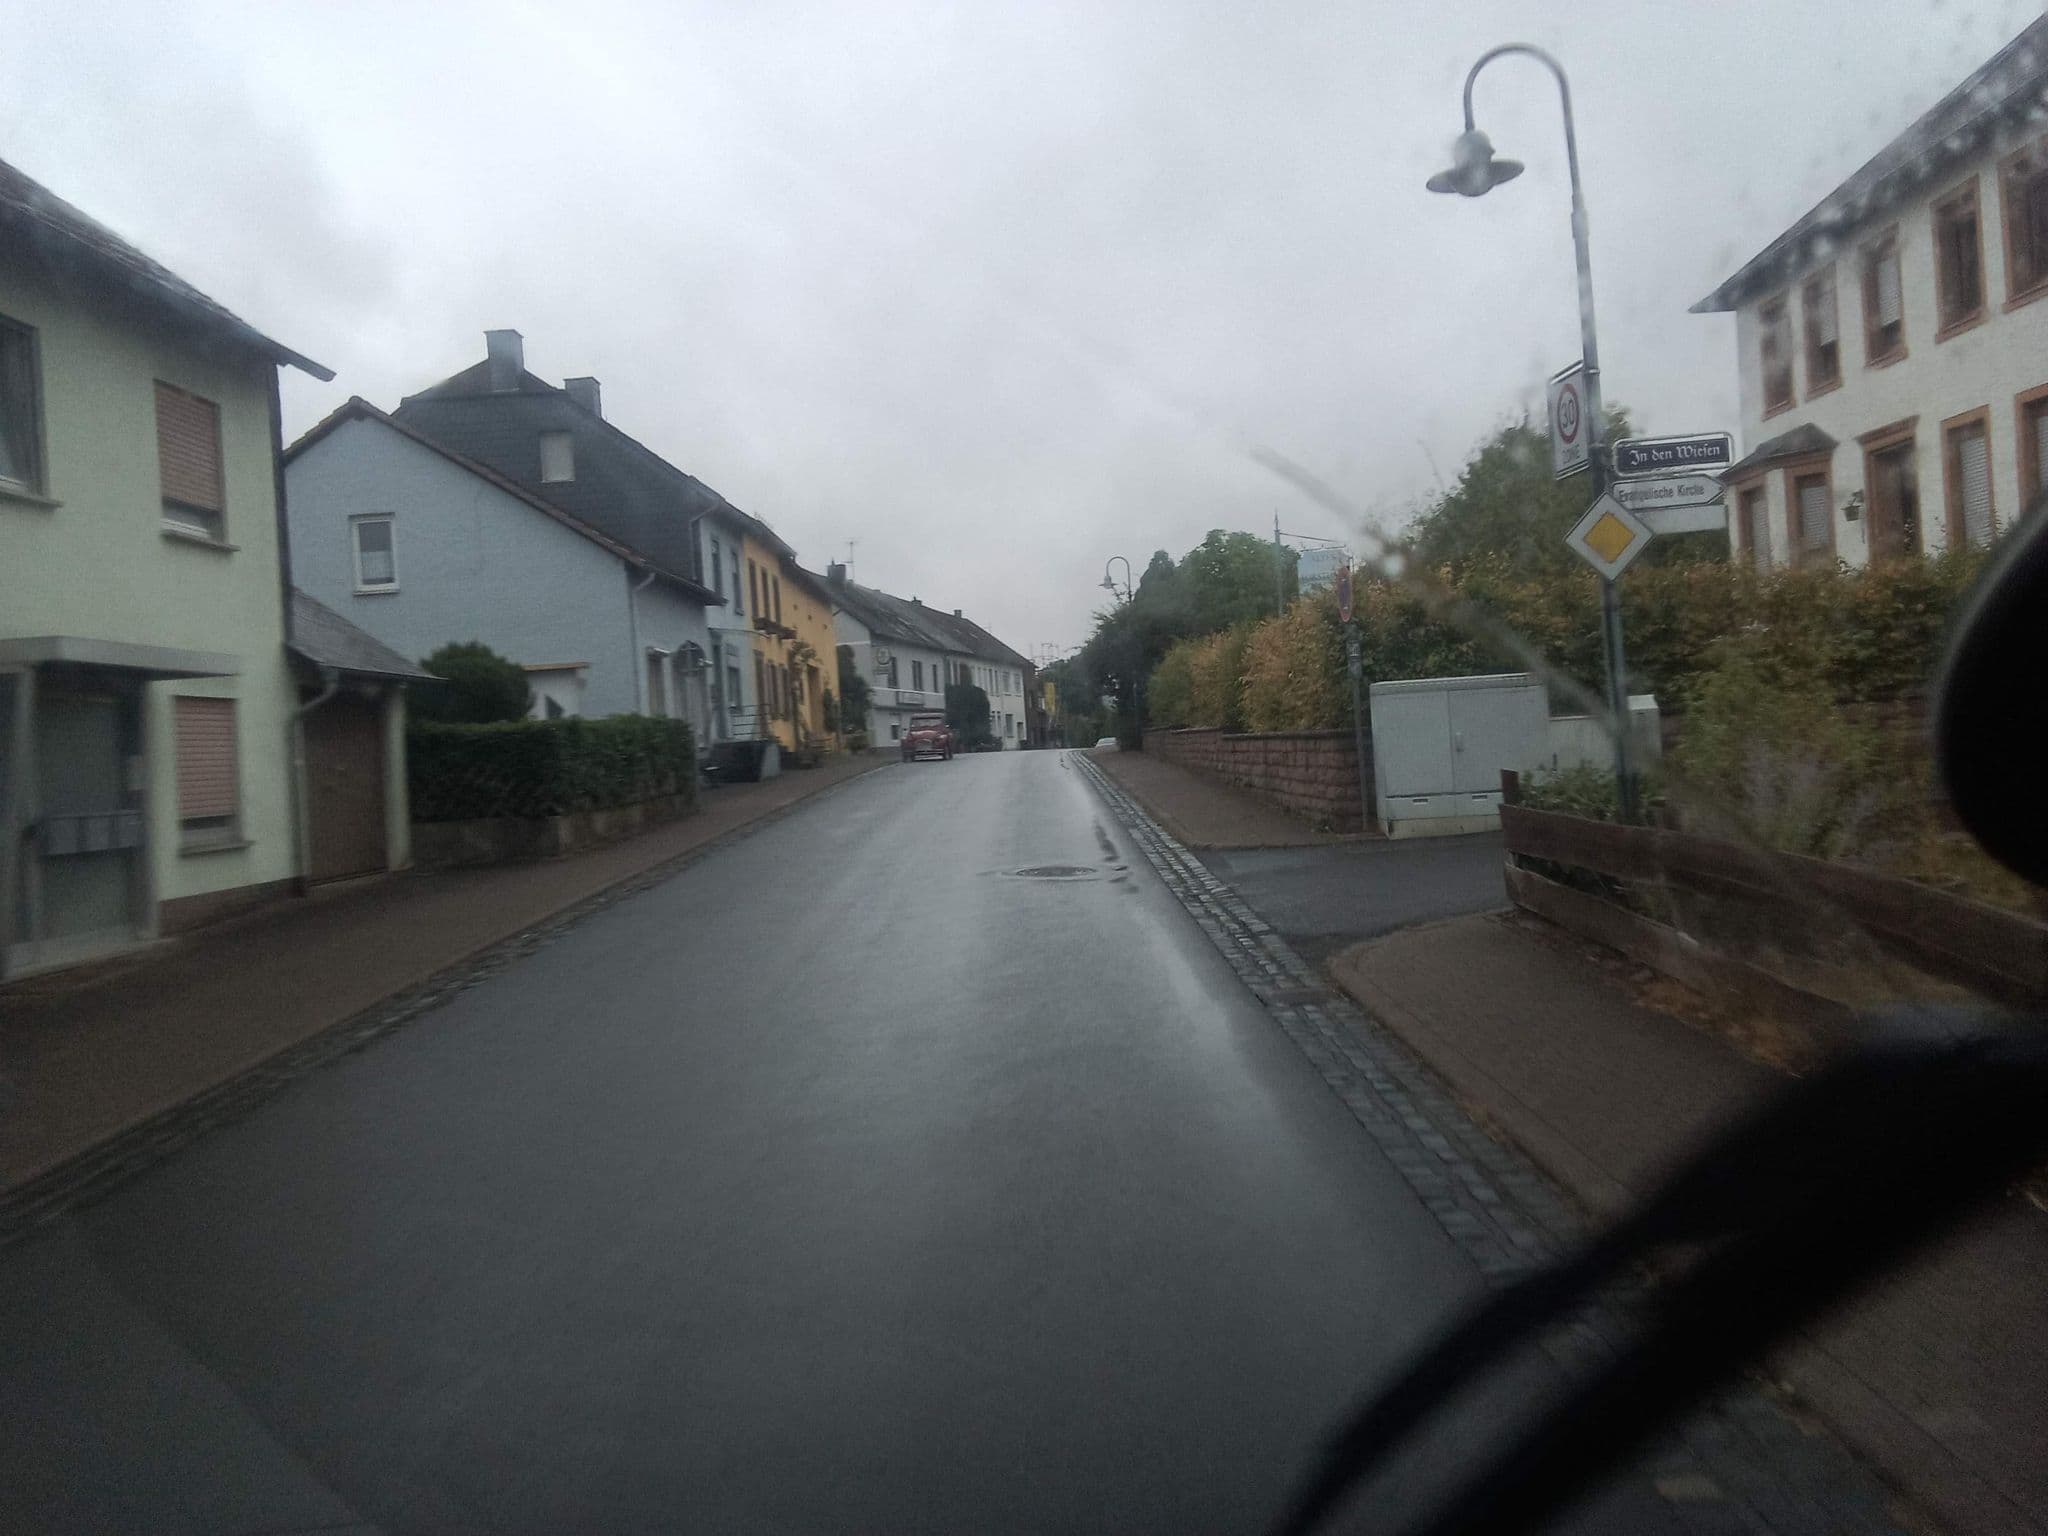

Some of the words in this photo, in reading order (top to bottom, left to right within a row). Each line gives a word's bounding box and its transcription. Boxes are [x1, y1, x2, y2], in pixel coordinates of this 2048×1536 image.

[1561, 399, 1576, 428] 30
[1629, 450, 1647, 466] In
[1652, 449, 1672, 462] den
